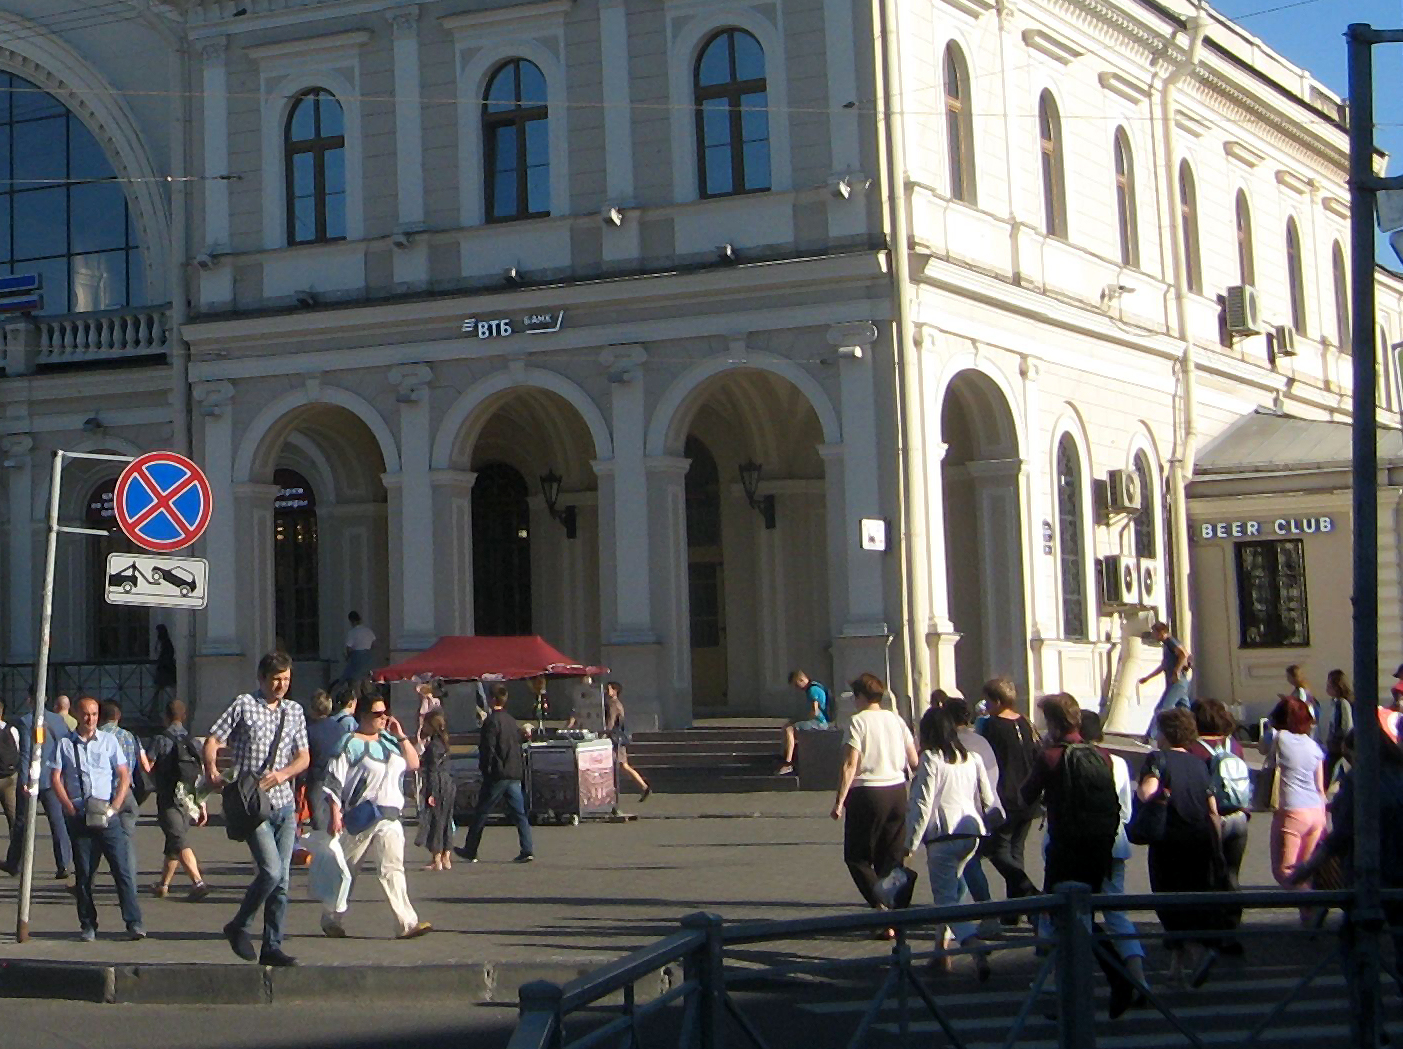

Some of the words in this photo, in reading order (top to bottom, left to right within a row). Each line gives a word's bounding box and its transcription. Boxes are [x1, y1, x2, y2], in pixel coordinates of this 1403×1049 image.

[477, 319, 512, 339] ВТБ
[1201, 521, 1259, 538] BEER
[1274, 517, 1331, 535] CLUB
